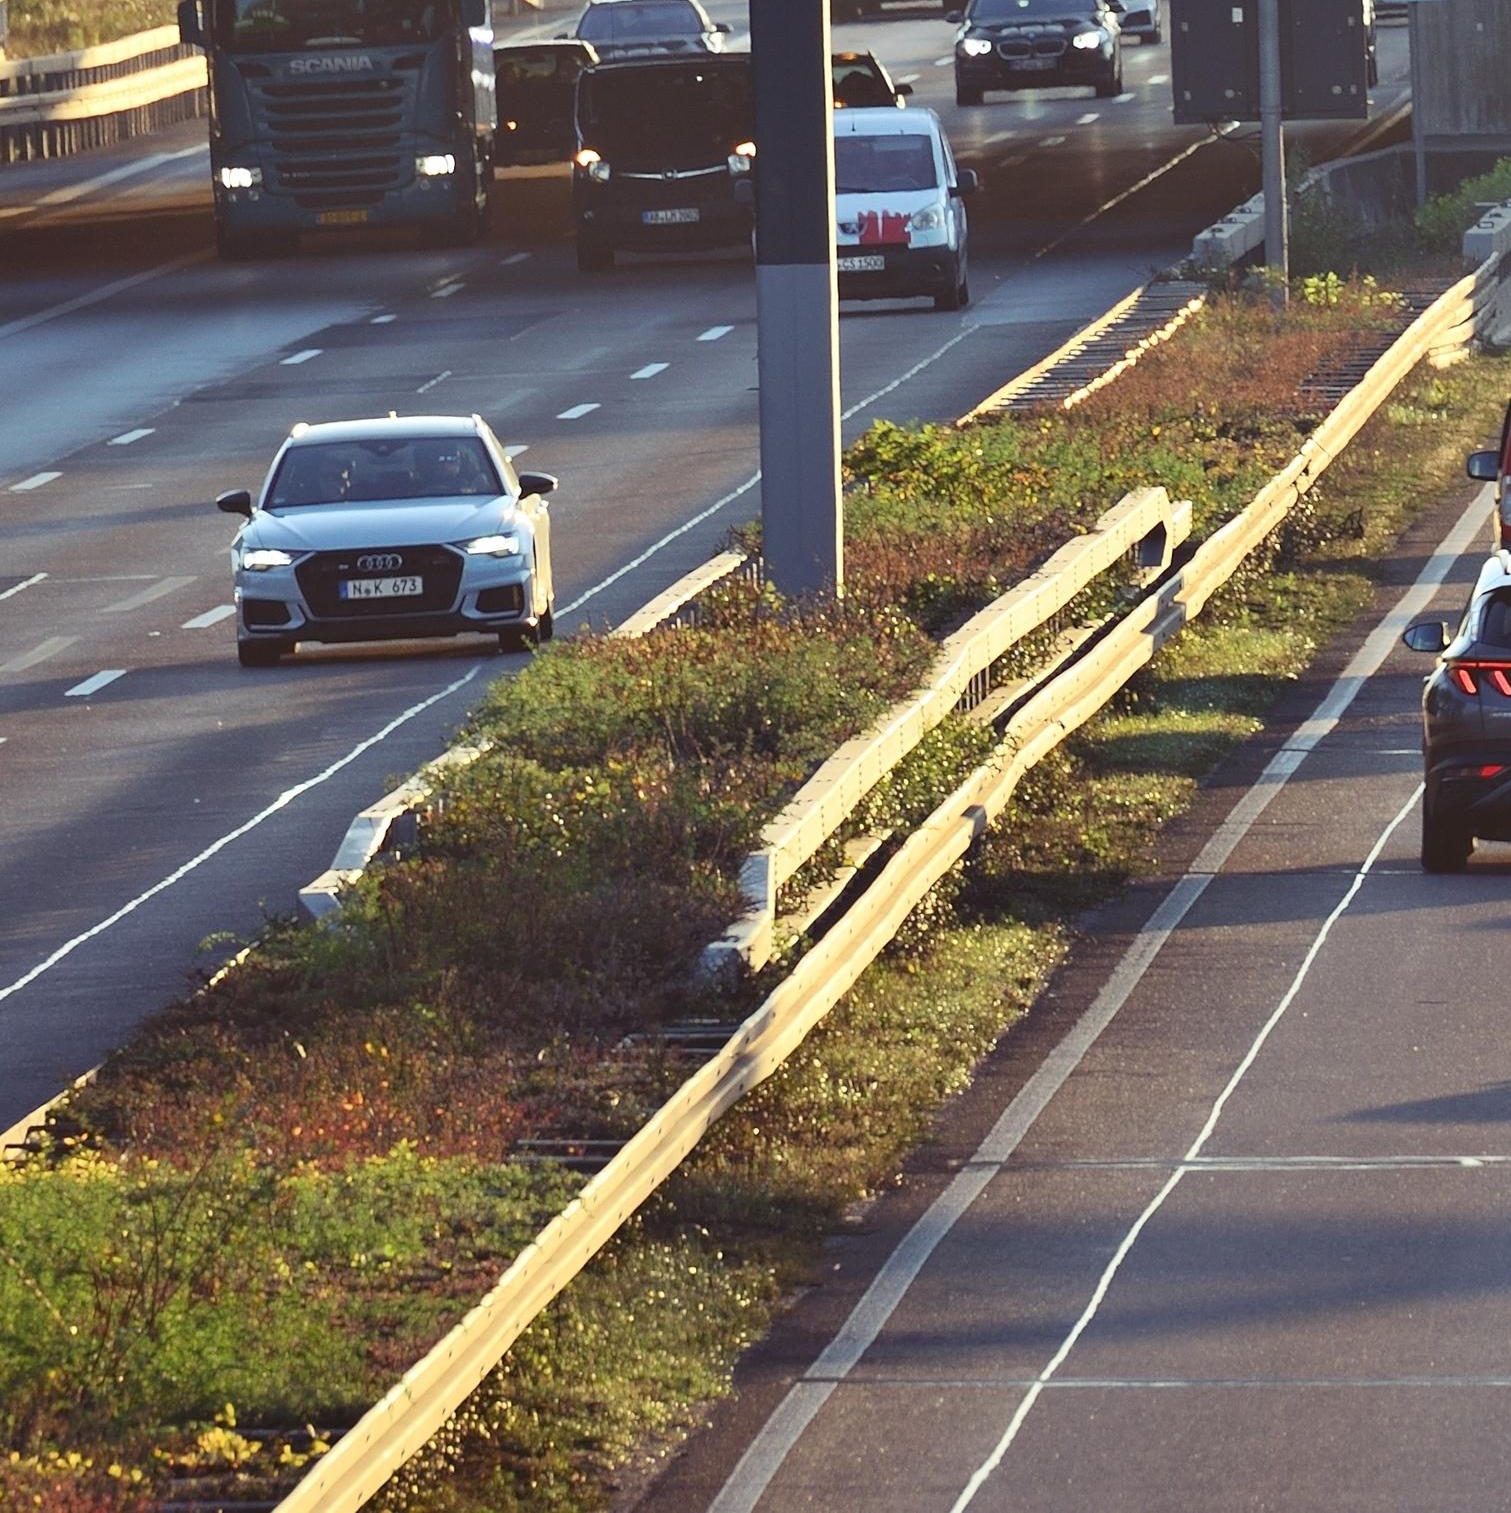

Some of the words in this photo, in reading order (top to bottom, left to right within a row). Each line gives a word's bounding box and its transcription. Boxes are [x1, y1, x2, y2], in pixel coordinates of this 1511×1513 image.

[289, 55, 374, 75] SCANIA
[352, 582, 362, 595] N
[374, 581, 383, 594] K
[392, 578, 417, 593] 673
